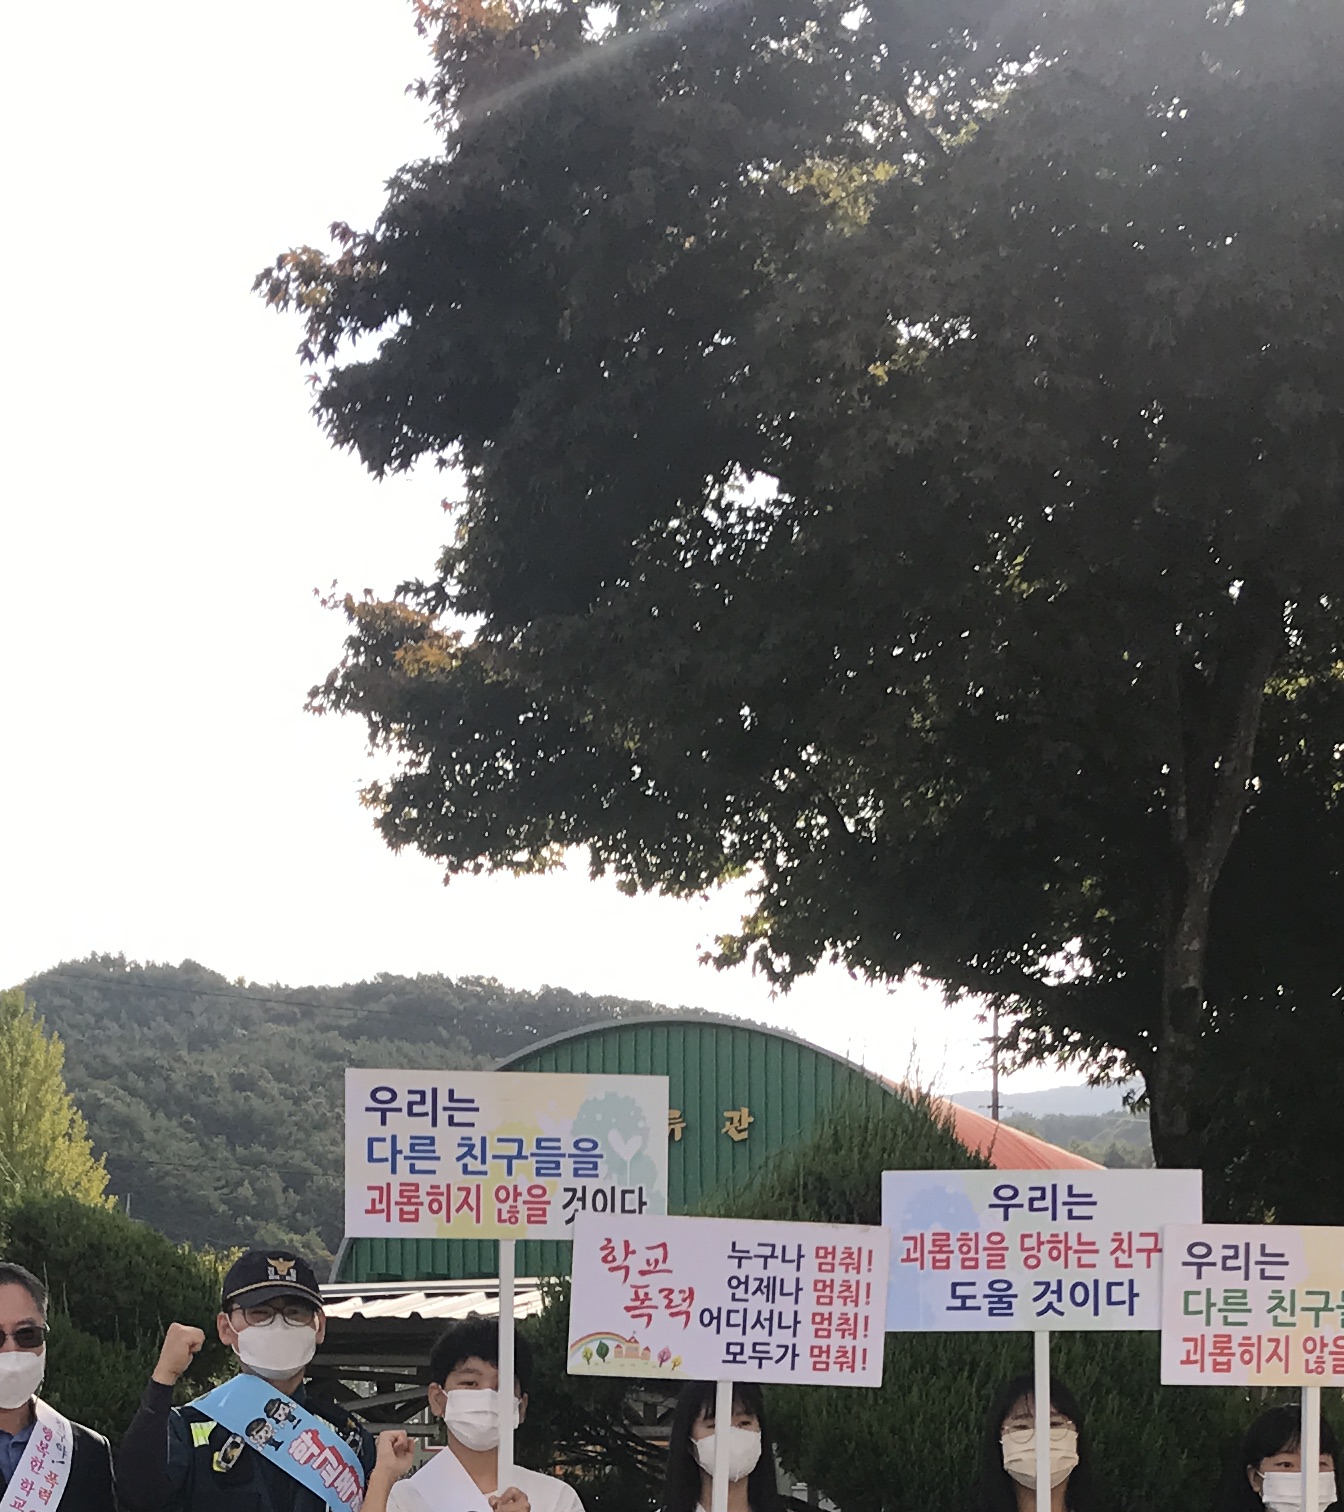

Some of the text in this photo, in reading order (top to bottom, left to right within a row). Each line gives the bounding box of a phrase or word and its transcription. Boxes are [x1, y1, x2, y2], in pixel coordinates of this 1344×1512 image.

[364, 1086, 480, 1127] 우리는
[366, 1134, 604, 1178] 다른 친구들을
[364, 1182, 481, 1224] 괴롭히지
[494, 1183, 551, 1225] 않을
[988, 1183, 1098, 1222] 우리는
[599, 1237, 674, 1284] 학교
[727, 1241, 874, 1274] 누구나 멈춰!
[900, 1231, 1163, 1270] 괴롭힘을 당하는 친구
[1181, 1241, 1289, 1281] 우리는
[624, 1284, 695, 1329] 폭력
[727, 1275, 872, 1307] 언제나 멈춰!
[945, 1278, 1140, 1317] 도울 것이다
[1183, 1287, 1252, 1327] 다른
[699, 1307, 869, 1340] 어디서나 멈춰!
[722, 1341, 867, 1373] 모두가 멈춰!
[1179, 1334, 1290, 1374] 괴롭히지
[30, 1425, 53, 1475] 행복한
[9, 1477, 35, 1512] 학교
[38, 1471, 59, 1505] 폭력
